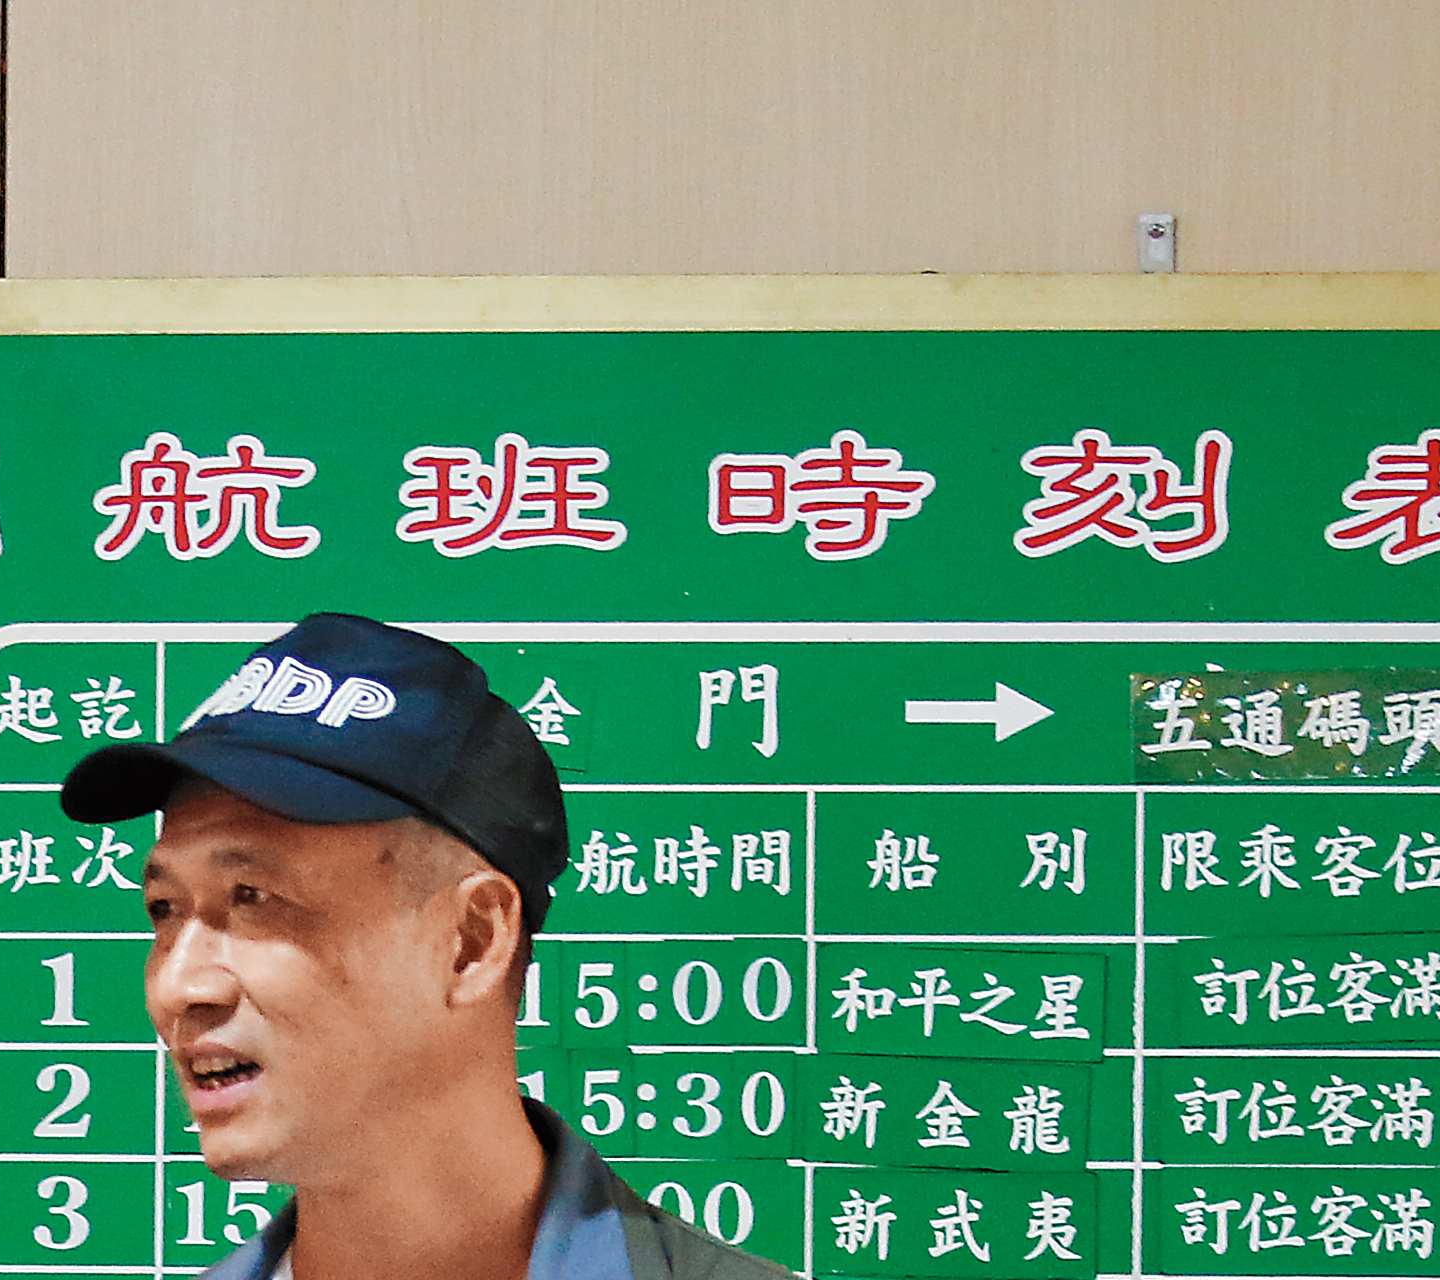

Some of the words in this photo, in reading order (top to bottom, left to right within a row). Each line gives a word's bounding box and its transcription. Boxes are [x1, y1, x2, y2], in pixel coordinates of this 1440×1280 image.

[548, 826, 793, 897] 航時間
[867, 829, 1087, 894] 船別
[41, 953, 89, 1025] 1
[516, 956, 791, 1028] 15:00
[832, 968, 1090, 1039] 和平之星
[34, 1064, 91, 1137] 2
[820, 1076, 1070, 1154] 新金龍
[1174, 1075, 1433, 1148] 訂位客滿
[33, 1176, 89, 1249] 3
[831, 1190, 1081, 1261] 新武夷
[1175, 1186, 1434, 1258] 訂位客滿
